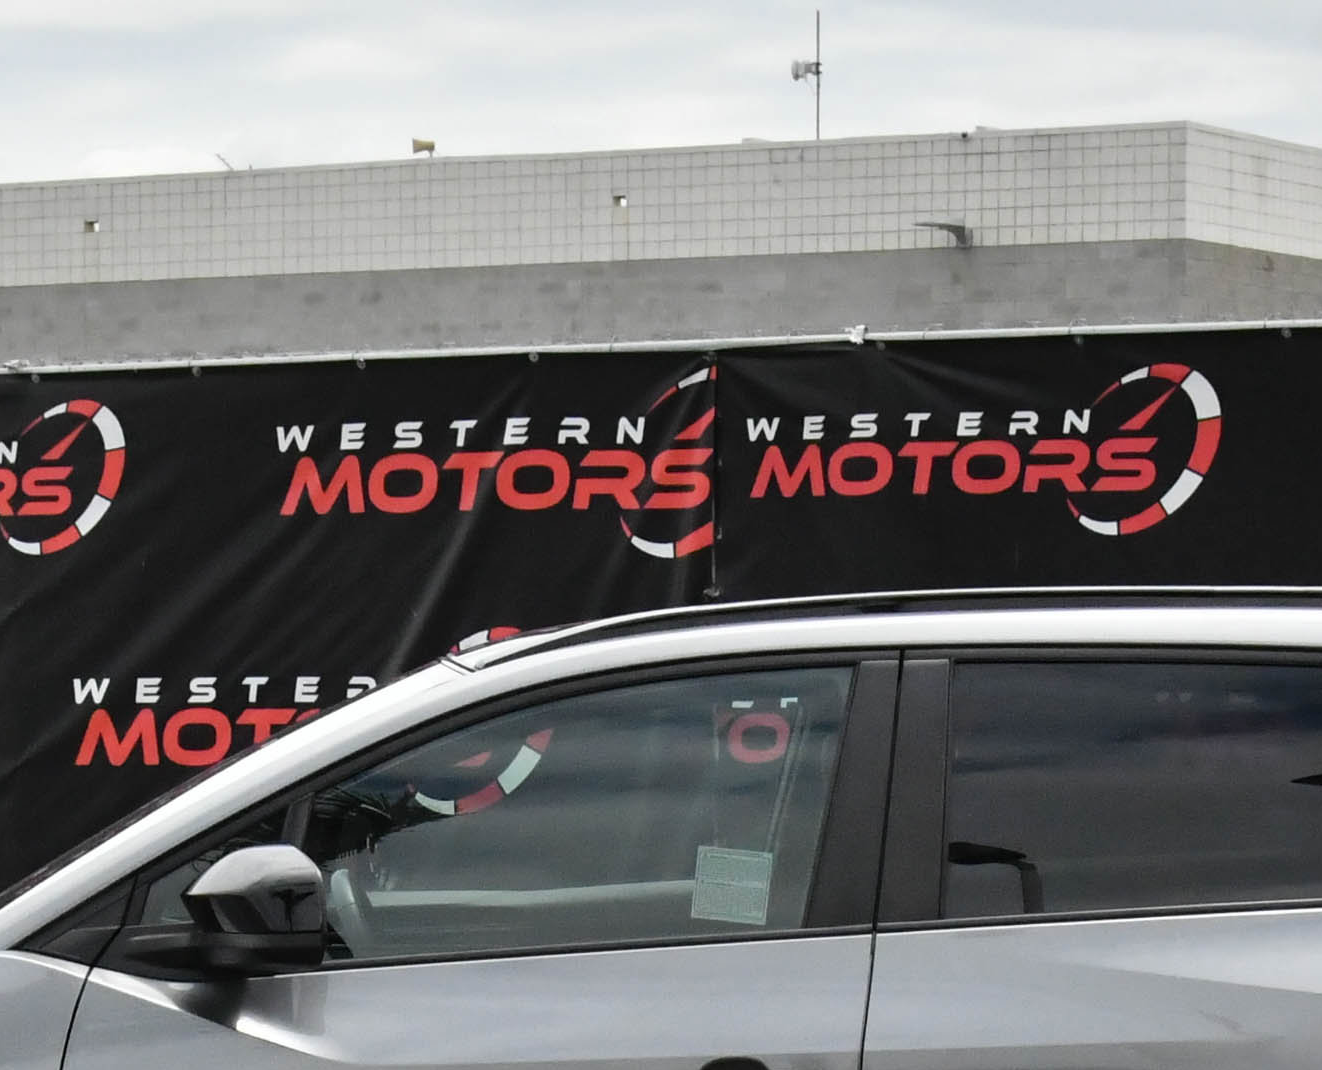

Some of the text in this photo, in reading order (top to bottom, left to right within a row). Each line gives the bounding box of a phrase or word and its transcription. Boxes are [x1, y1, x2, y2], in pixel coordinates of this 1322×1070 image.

[277, 417, 645, 454] WESTERN
[747, 409, 1090, 441] WESTERN
[281, 448, 713, 515] MOTORS
[751, 437, 1157, 498] MOTORS
[73, 676, 377, 704] WESTER
[76, 708, 320, 767] MOT
